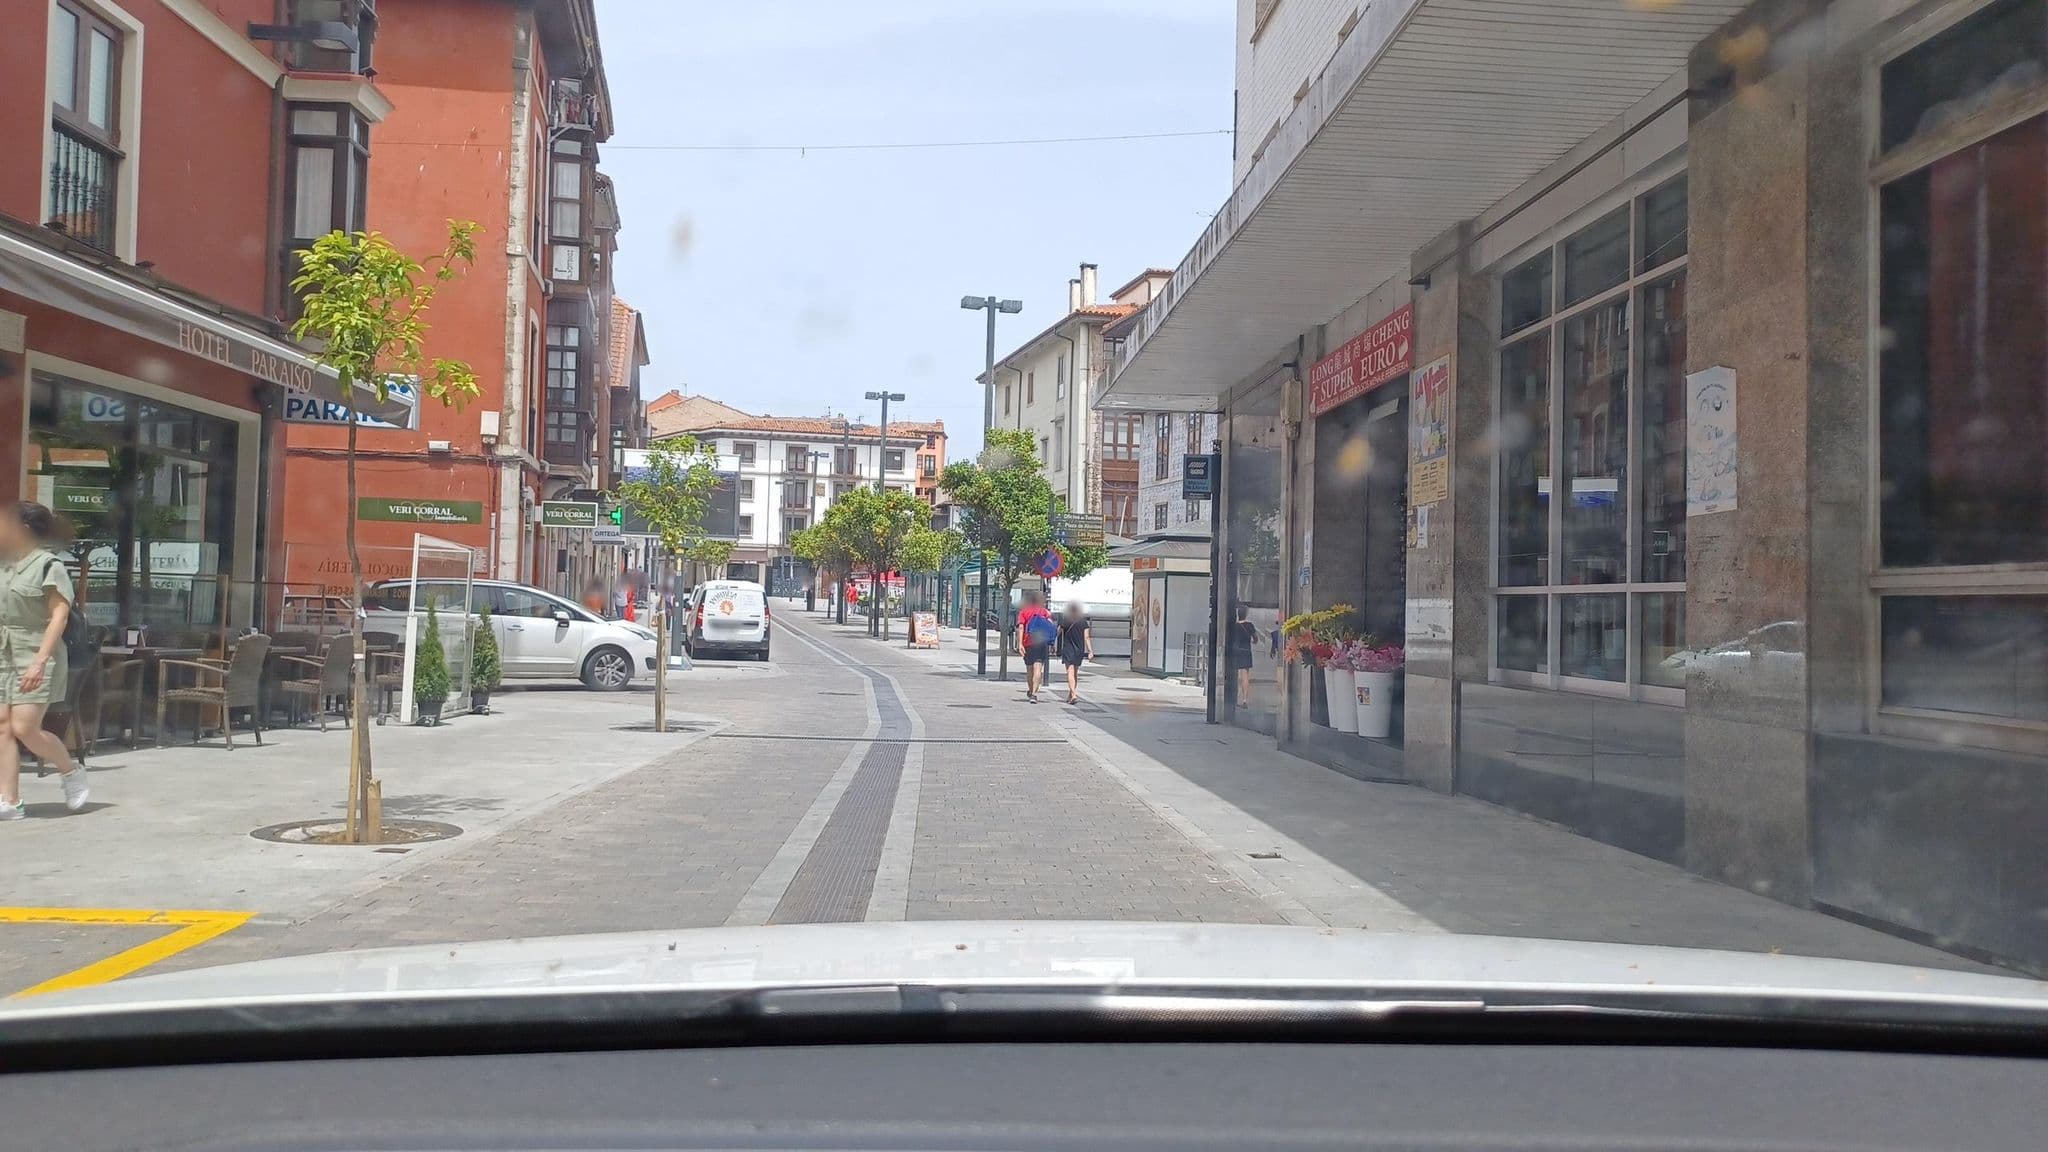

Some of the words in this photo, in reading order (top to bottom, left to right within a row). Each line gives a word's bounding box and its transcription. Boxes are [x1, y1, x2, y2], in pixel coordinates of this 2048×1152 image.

[1372, 310, 1410, 347] CHENG
[178, 320, 233, 365] HOTEL
[251, 349, 312, 393] PARAISO
[1320, 366, 1354, 402] SUPER
[1360, 341, 1396, 380] EURO
[389, 505, 412, 515] VERI
[413, 505, 453, 516] CORRAL
[545, 510, 563, 518] VERI
[564, 510, 593, 519] CORRAL
